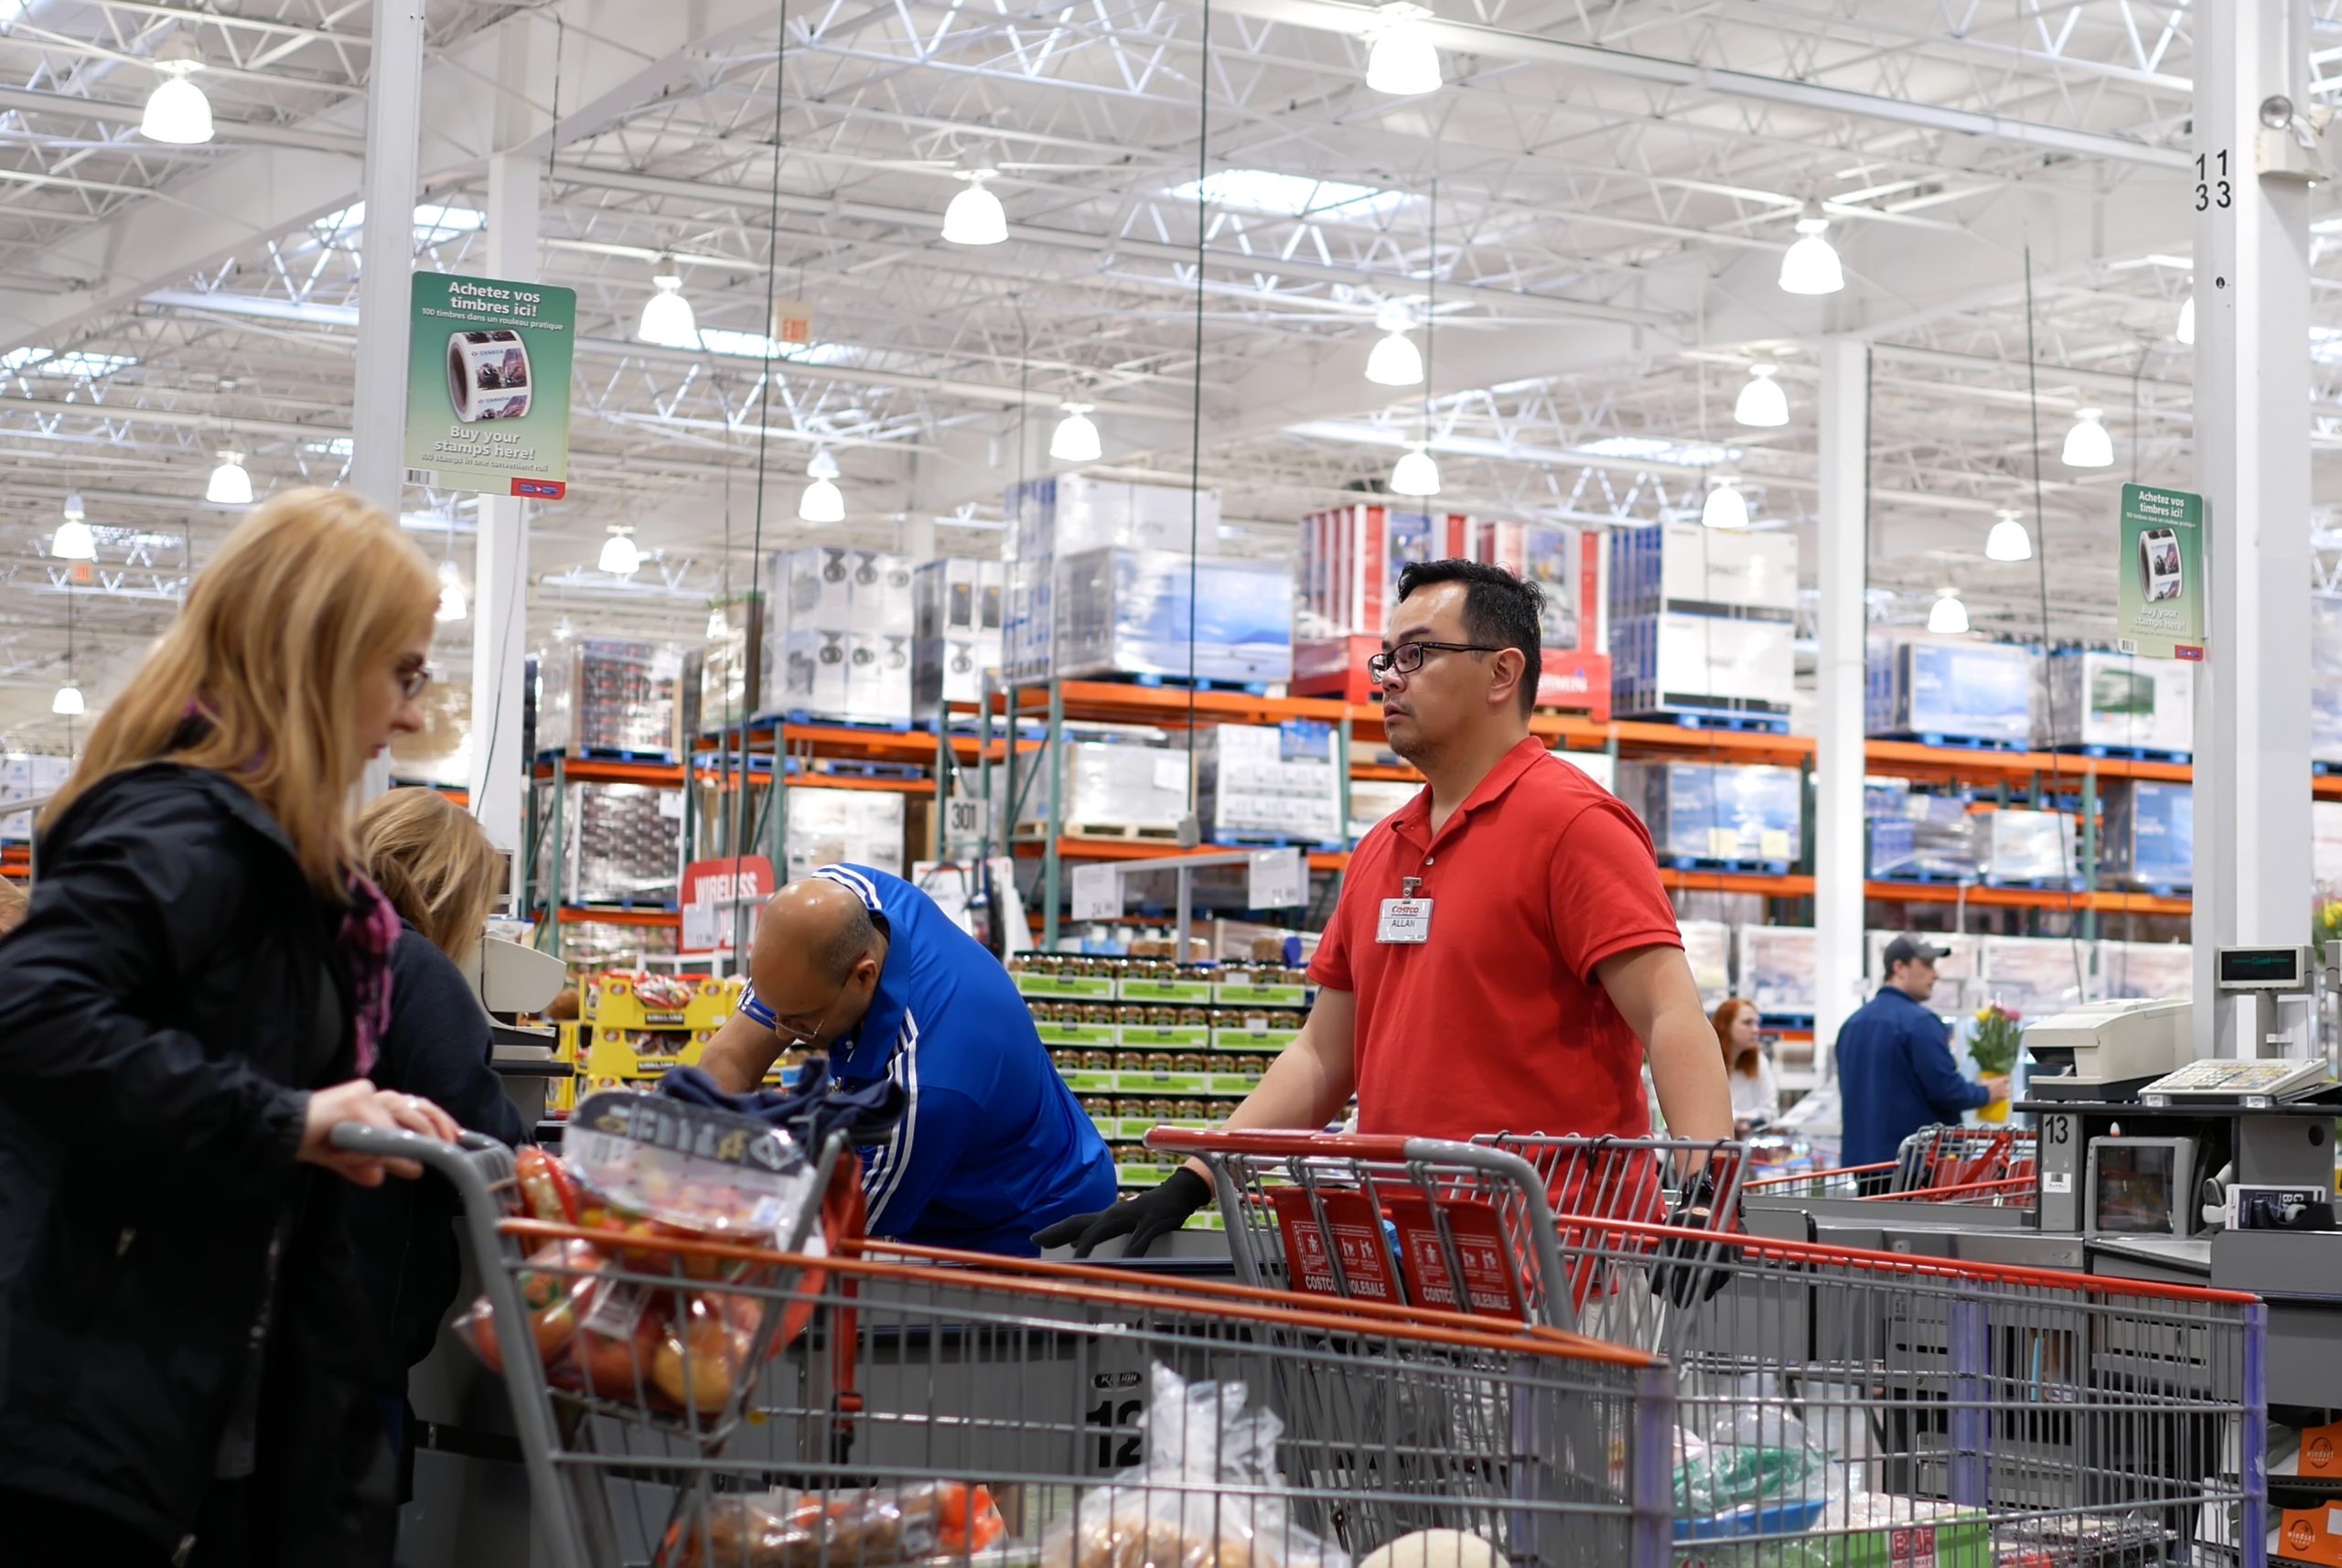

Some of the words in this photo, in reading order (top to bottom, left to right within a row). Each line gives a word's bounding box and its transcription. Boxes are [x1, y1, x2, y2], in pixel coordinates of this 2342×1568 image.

[448, 281, 510, 300] Achetez
[514, 291, 541, 303] vos
[450, 296, 510, 315] timbres
[514, 303, 538, 317] ici!
[422, 307, 435, 316] 100
[436, 309, 466, 319] timbres
[467, 313, 486, 322] dans
[500, 317, 529, 327] rouleau
[530, 321, 564, 331] pratique
[450, 425, 480, 443] Buy
[483, 431, 521, 445] your
[434, 441, 491, 458] stamps
[494, 444, 535, 460] here!
[2138, 490, 2169, 504] Achetez
[2170, 498, 2185, 507] vos
[2140, 502, 2169, 516] timbres
[2171, 507, 2184, 519] ici!
[2142, 604, 2158, 618] Buy
[2158, 608, 2177, 619] your
[2134, 615, 2164, 629] stamps
[2164, 618, 2186, 631] here!
[951, 801, 976, 830] 301
[1391, 918, 1415, 928] ALLAN
[2045, 1115, 2068, 1144] 13
[1086, 1399, 1143, 1468] 12
[2306, 1450, 2334, 1458] windset
[2287, 1530, 2315, 1541] windset
